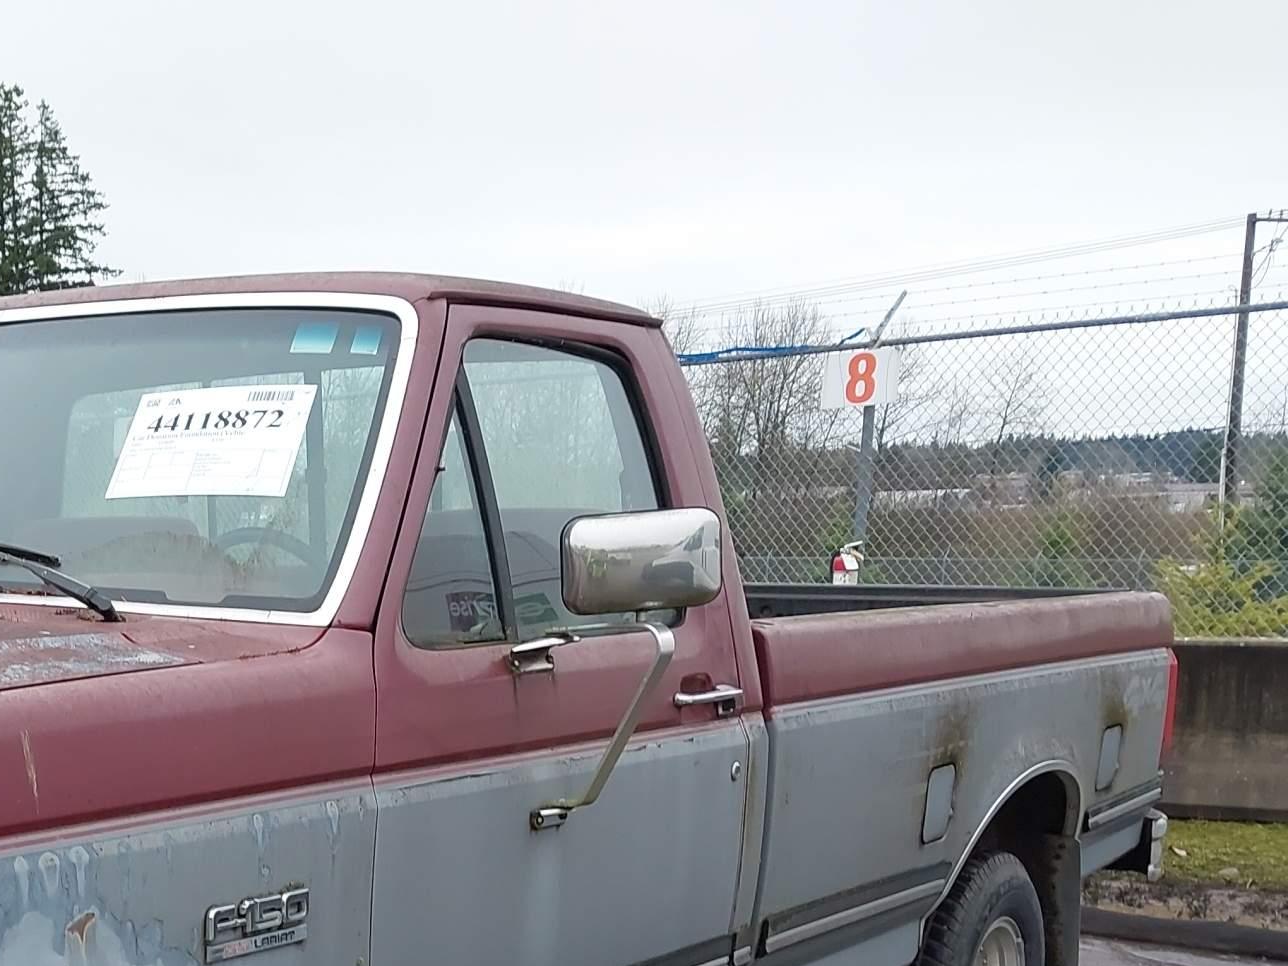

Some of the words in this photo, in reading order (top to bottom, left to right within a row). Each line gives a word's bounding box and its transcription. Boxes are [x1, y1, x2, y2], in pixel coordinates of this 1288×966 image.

[844, 351, 878, 404] 8
[146, 408, 285, 433] 44118872
[205, 887, 310, 942] F-150
[253, 930, 296, 949] LARIAT
